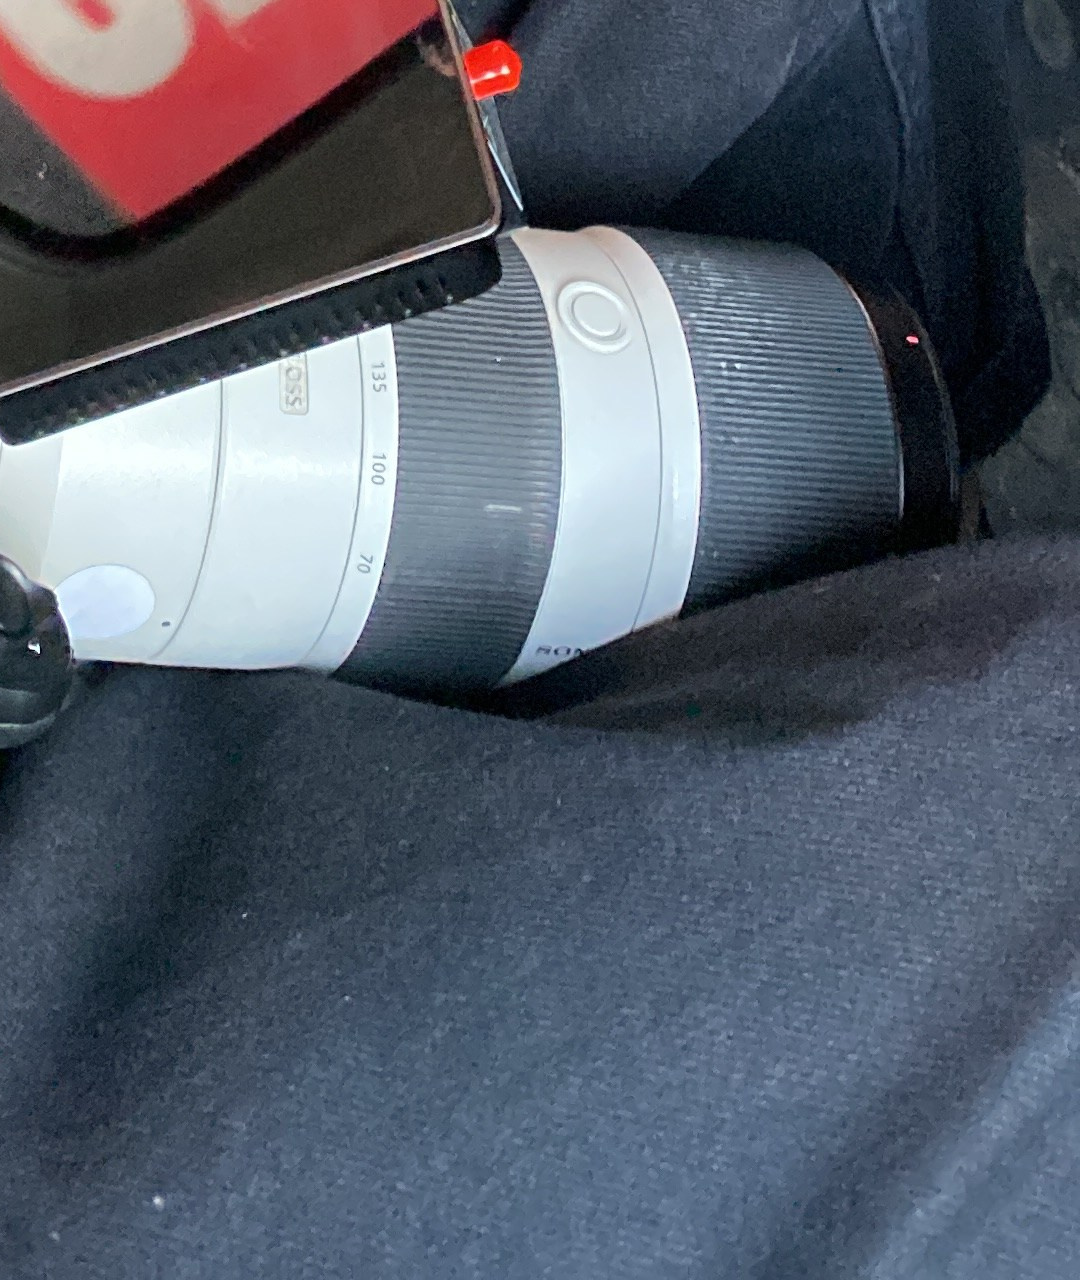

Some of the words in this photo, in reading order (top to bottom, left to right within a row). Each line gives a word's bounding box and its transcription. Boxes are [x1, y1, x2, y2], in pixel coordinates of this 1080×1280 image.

[371, 362, 387, 393] 135
[371, 452, 387, 486] 100
[357, 554, 374, 575] 70
